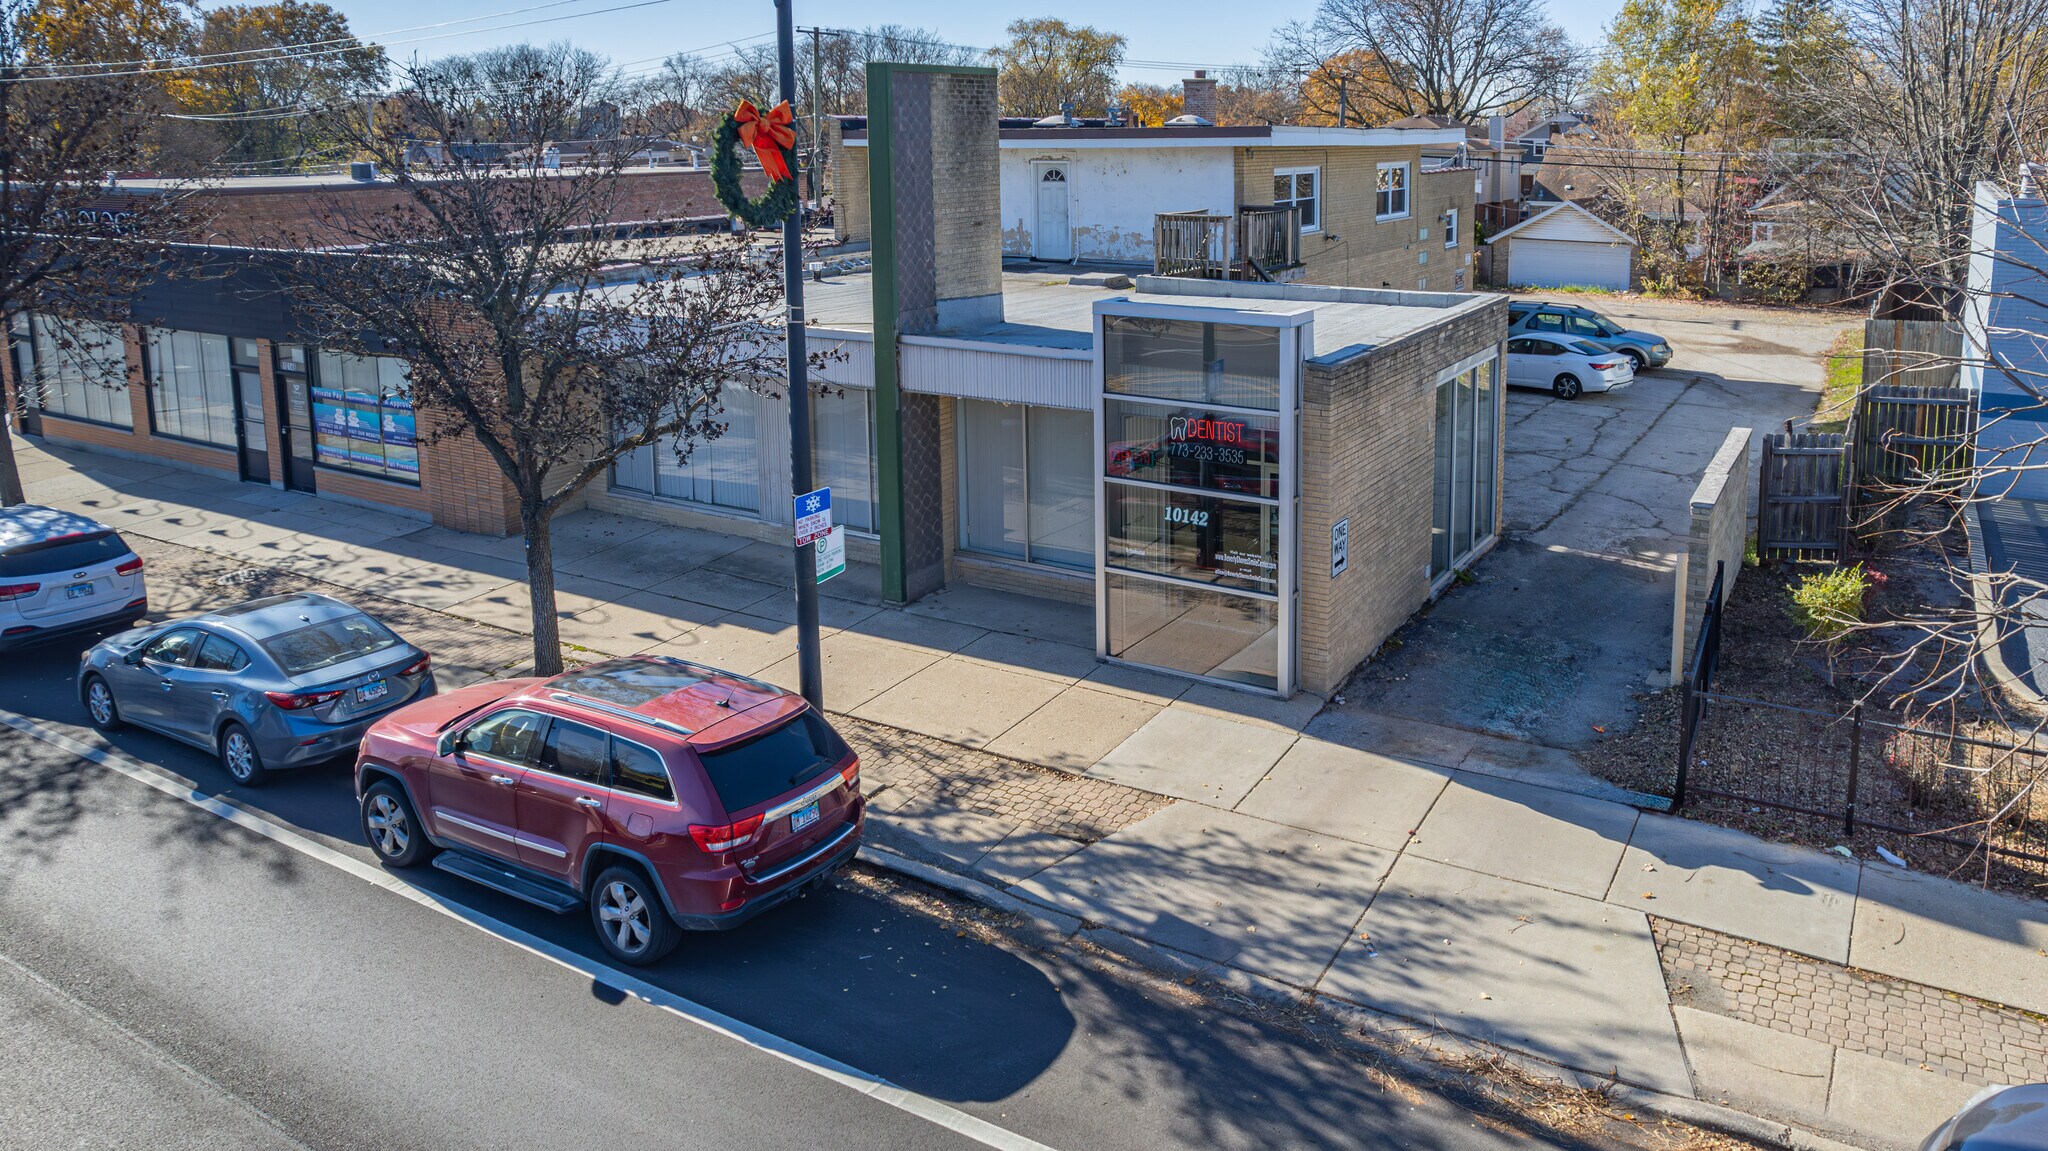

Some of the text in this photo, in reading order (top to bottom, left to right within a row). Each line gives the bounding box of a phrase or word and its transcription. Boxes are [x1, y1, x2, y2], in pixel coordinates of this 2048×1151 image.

[313, 388, 342, 401] Private Pay
[1187, 417, 1245, 443] DENTIST
[1170, 441, 1244, 465] 773-233-3535
[805, 513, 821, 522] PARKING
[1164, 506, 1209, 526] 10142
[798, 529, 830, 545] TOW ZONE
[1335, 523, 1347, 541] ONE
[1334, 537, 1347, 556] WAY
